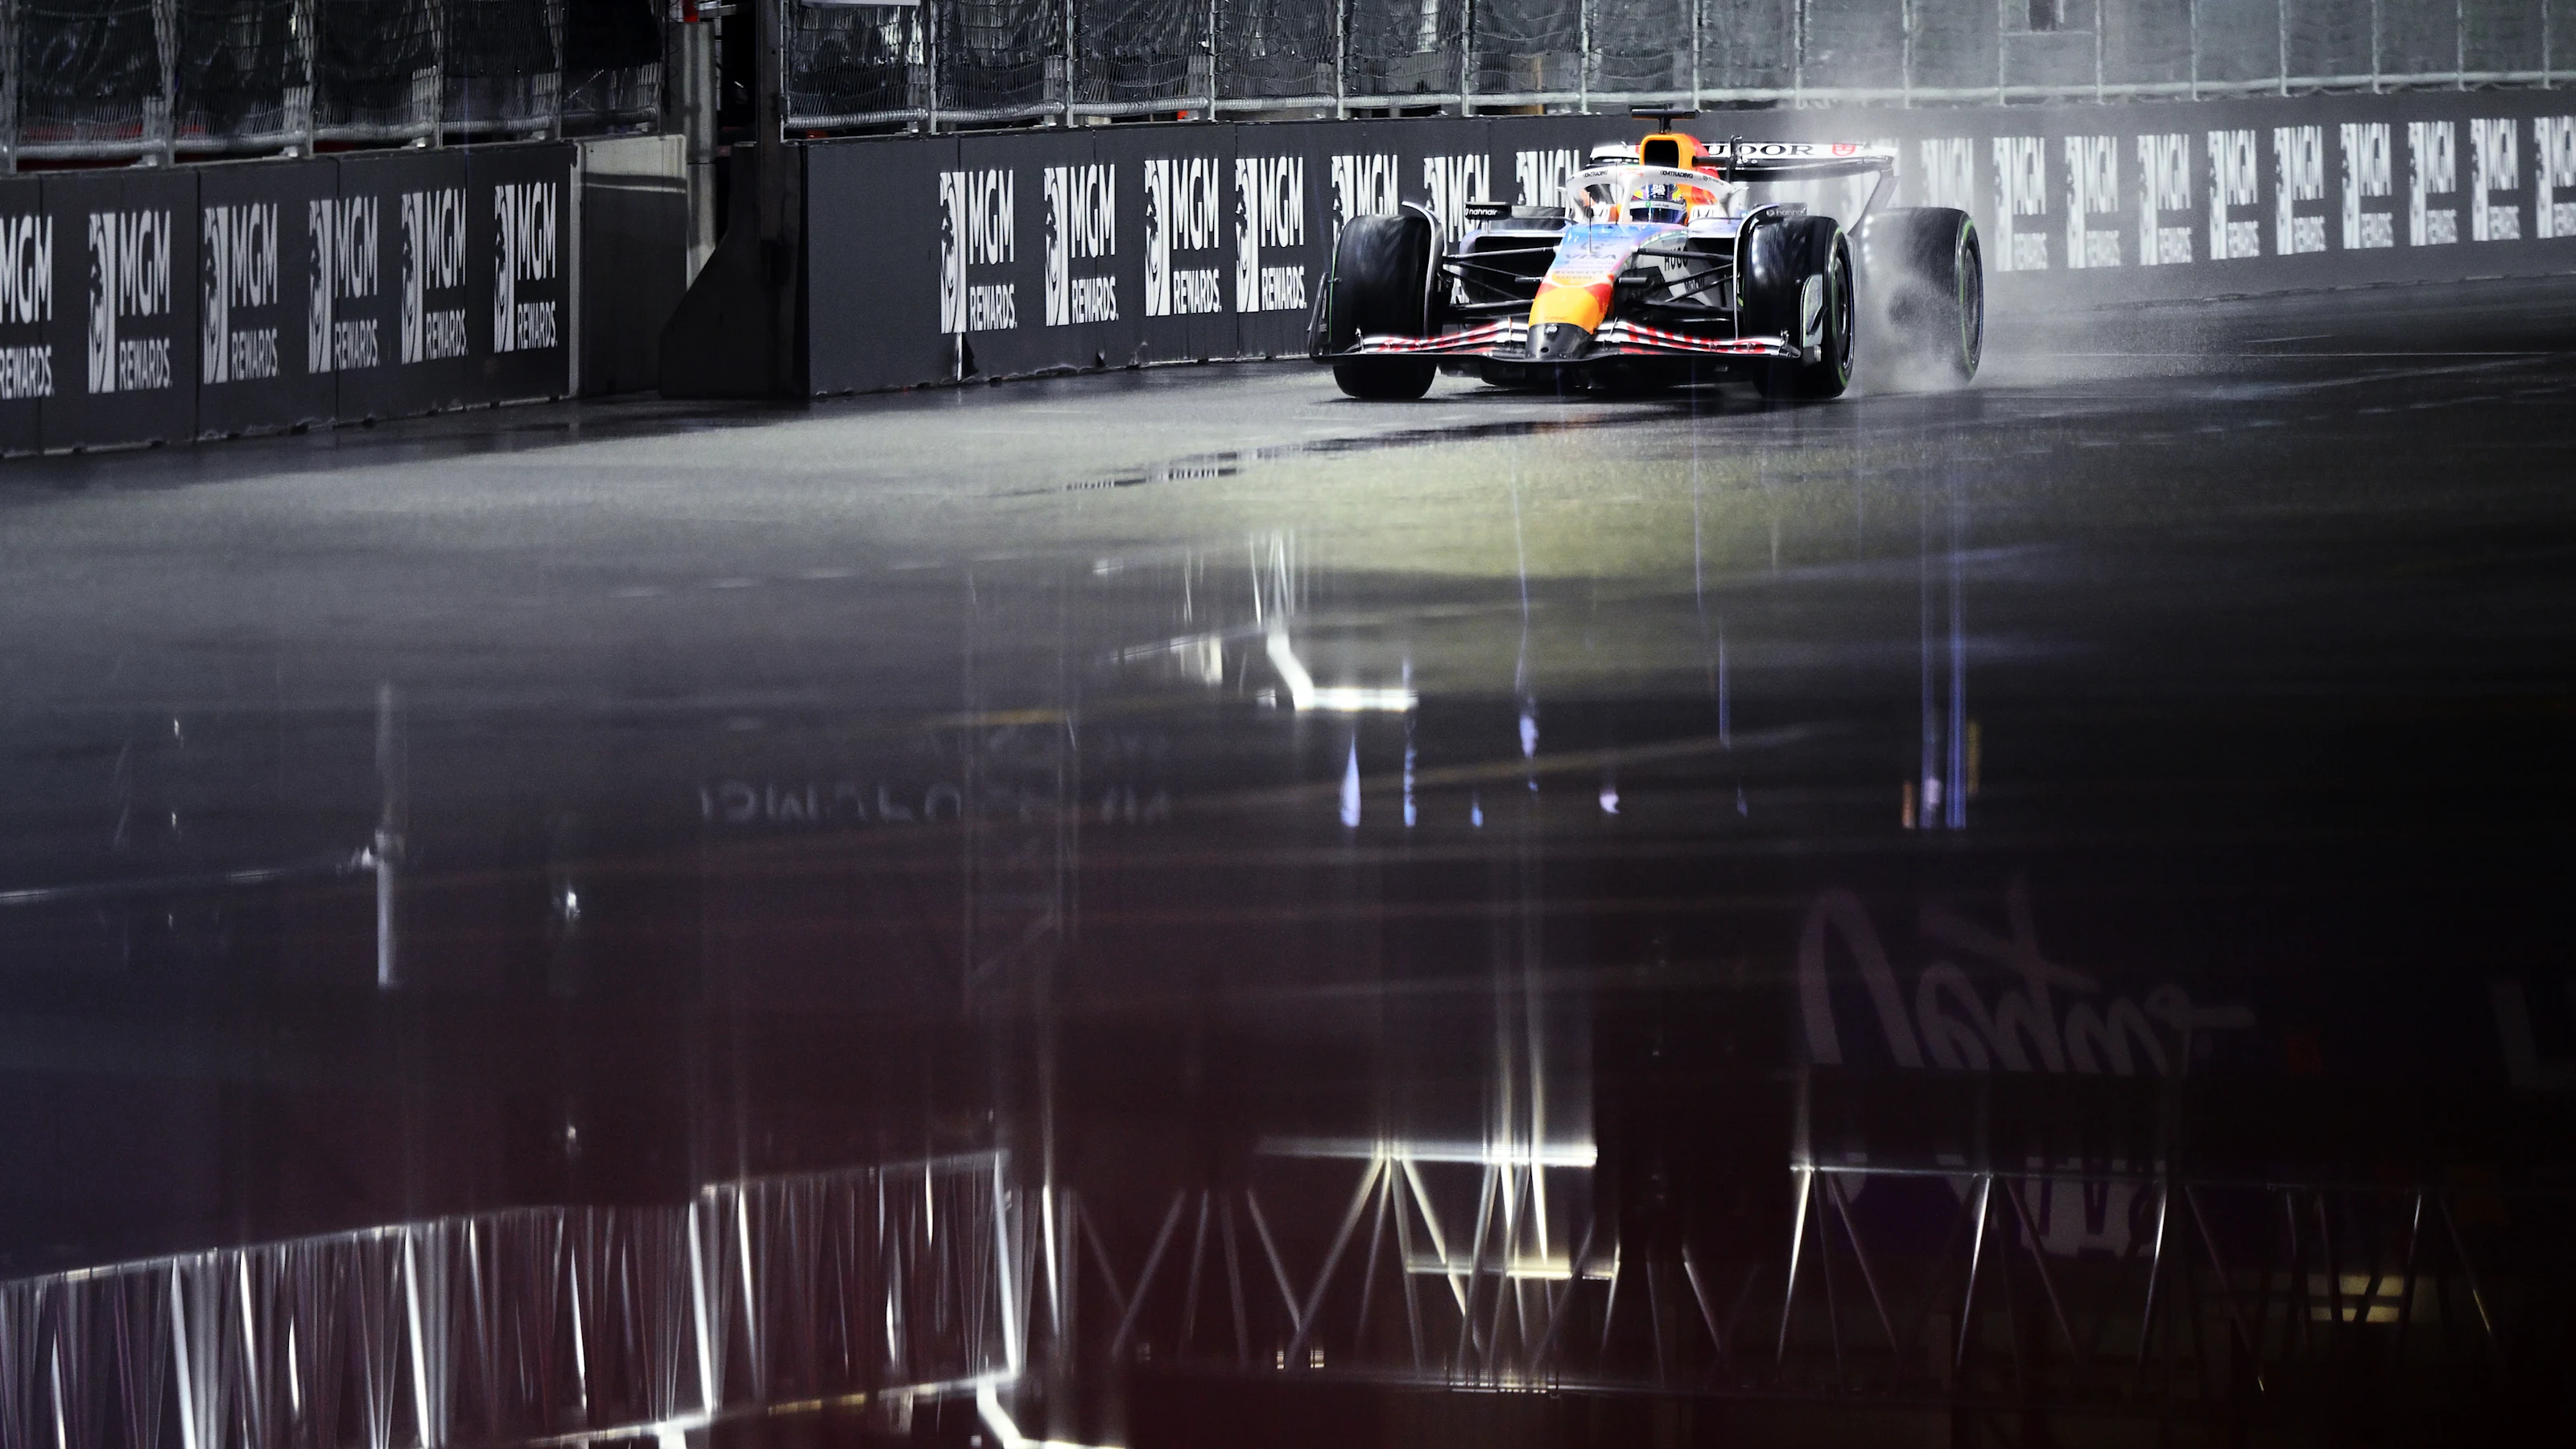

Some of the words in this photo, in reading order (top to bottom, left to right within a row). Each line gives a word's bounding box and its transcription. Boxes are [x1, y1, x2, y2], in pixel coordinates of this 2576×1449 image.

[335, 196, 378, 299] MGM
[426, 187, 467, 290] MGM
[518, 181, 556, 281] MGM
[969, 169, 1014, 265] MGM
[1071, 163, 1116, 258] MGM
[1173, 158, 1219, 250] MGM
[1261, 156, 1304, 248] MGM
[1468, 208, 1498, 216] hahnair
[0, 214, 52, 324] MGM
[120, 210, 171, 316] MGM
[232, 203, 278, 308] MGM
